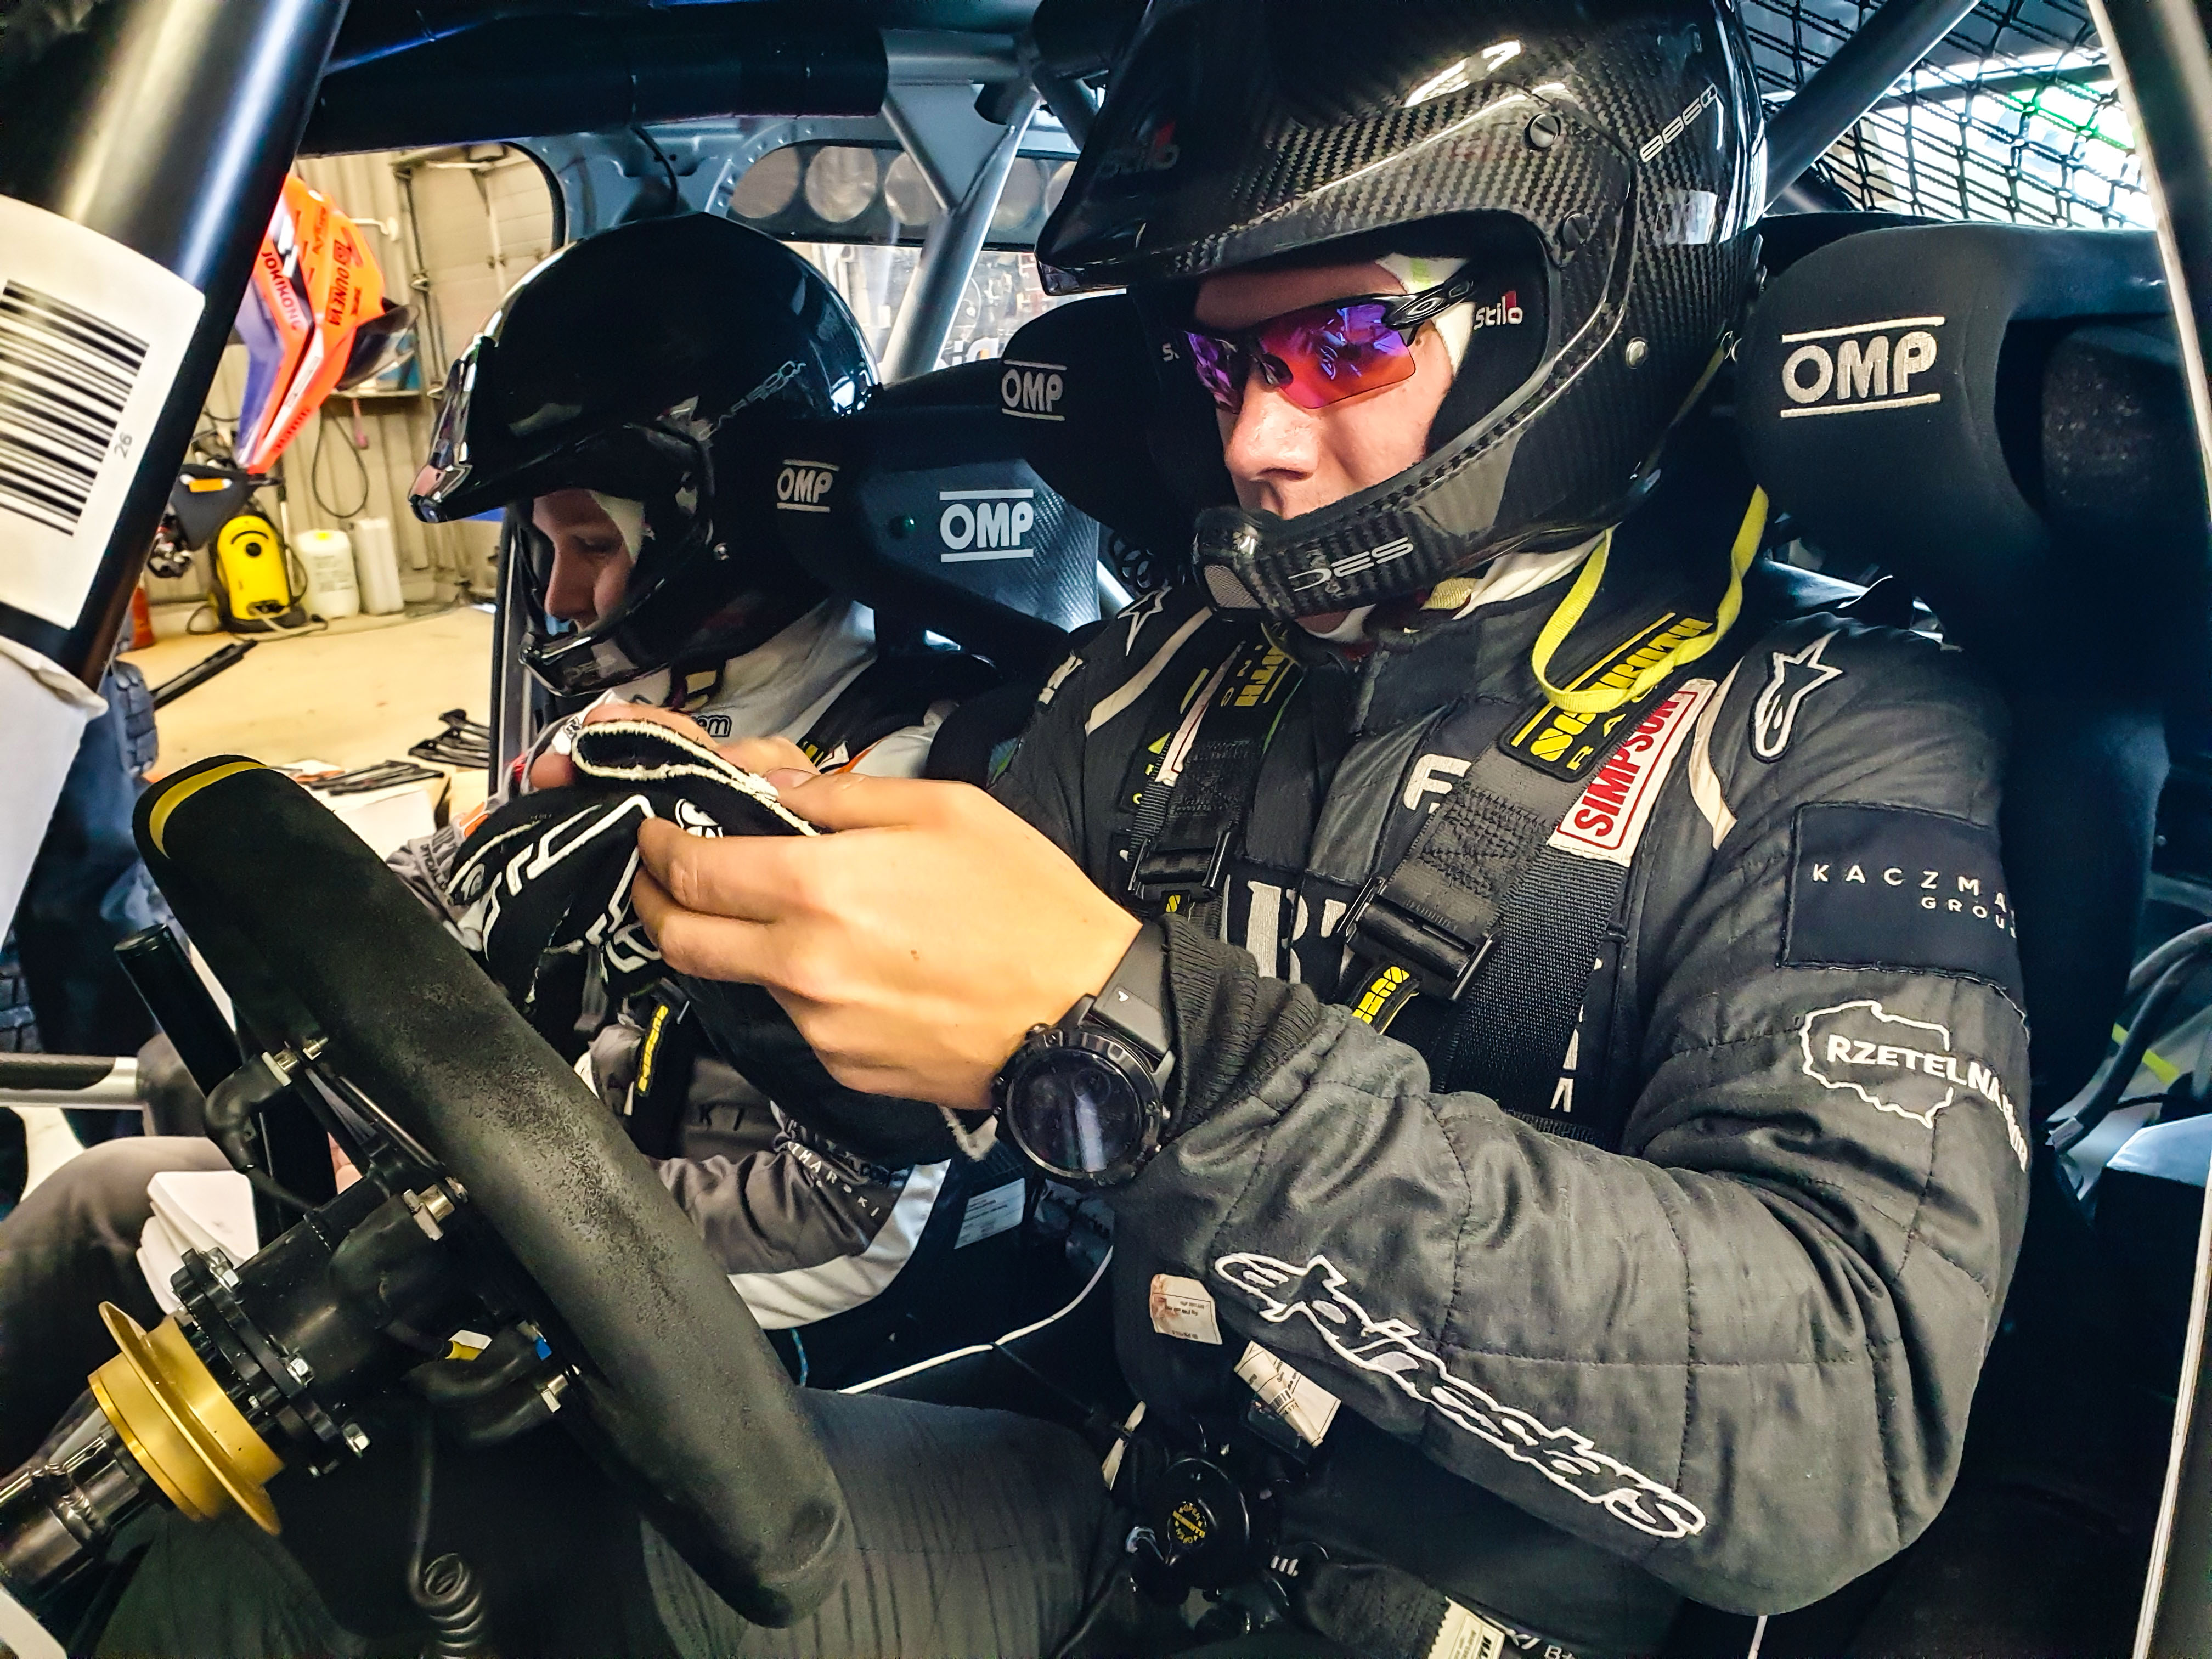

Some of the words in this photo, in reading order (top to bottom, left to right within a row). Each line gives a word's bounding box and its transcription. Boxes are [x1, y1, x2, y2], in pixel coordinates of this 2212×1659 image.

[1474, 295, 1523, 330] stilo
[1782, 330, 1938, 404] OMP
[1002, 368, 1064, 413] OMP
[114, 432, 133, 459] 26
[777, 469, 833, 503] OMP
[940, 502, 1034, 550] OMP
[1530, 618, 1713, 762] SCROTH
[1574, 700, 1680, 837] SIMPSON
